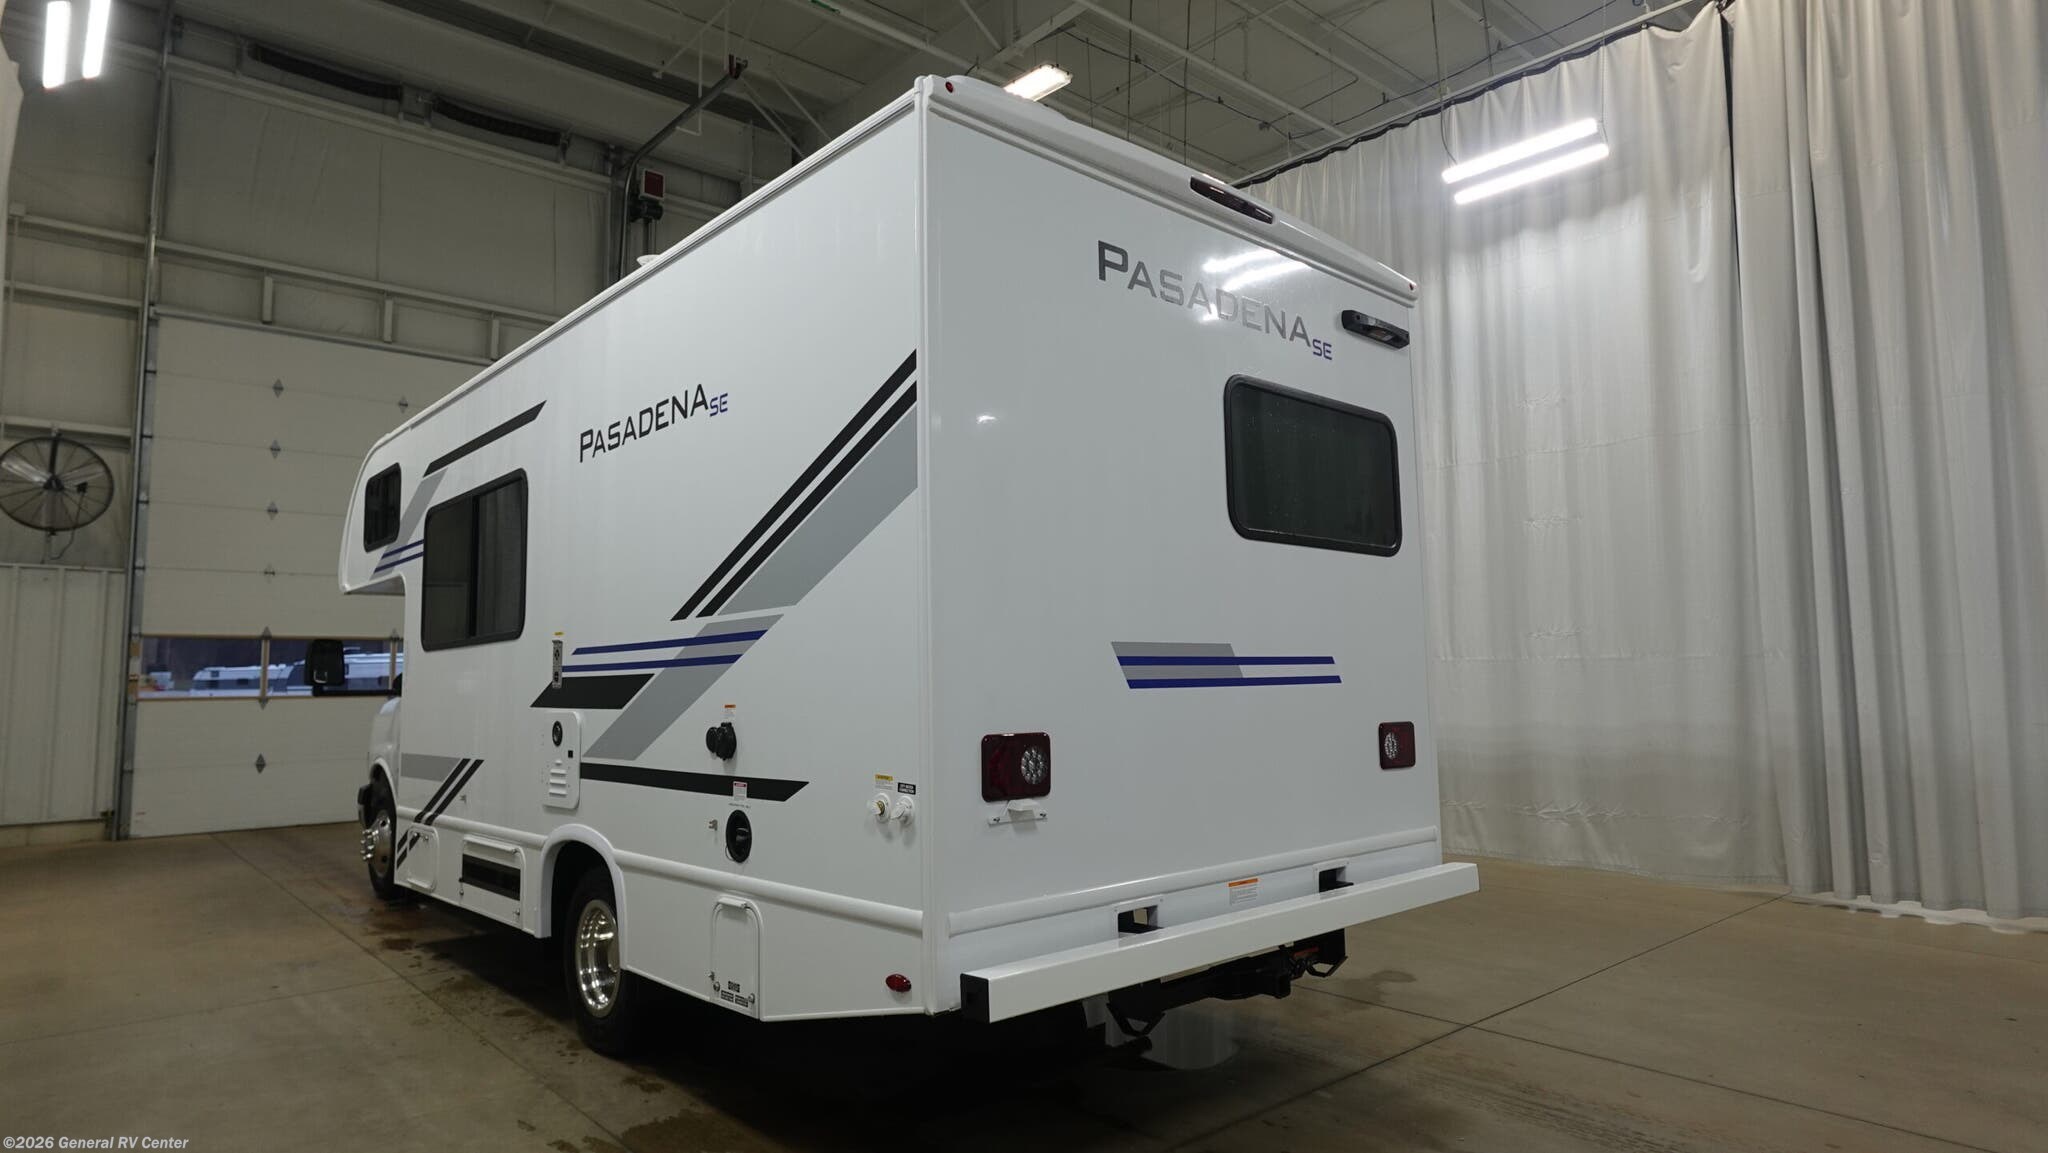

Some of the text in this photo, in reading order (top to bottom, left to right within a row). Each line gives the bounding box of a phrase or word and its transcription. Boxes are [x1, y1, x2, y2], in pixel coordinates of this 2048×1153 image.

[1098, 240, 1333, 361] PASADENA SE
[580, 384, 728, 463] PASADENA SE
